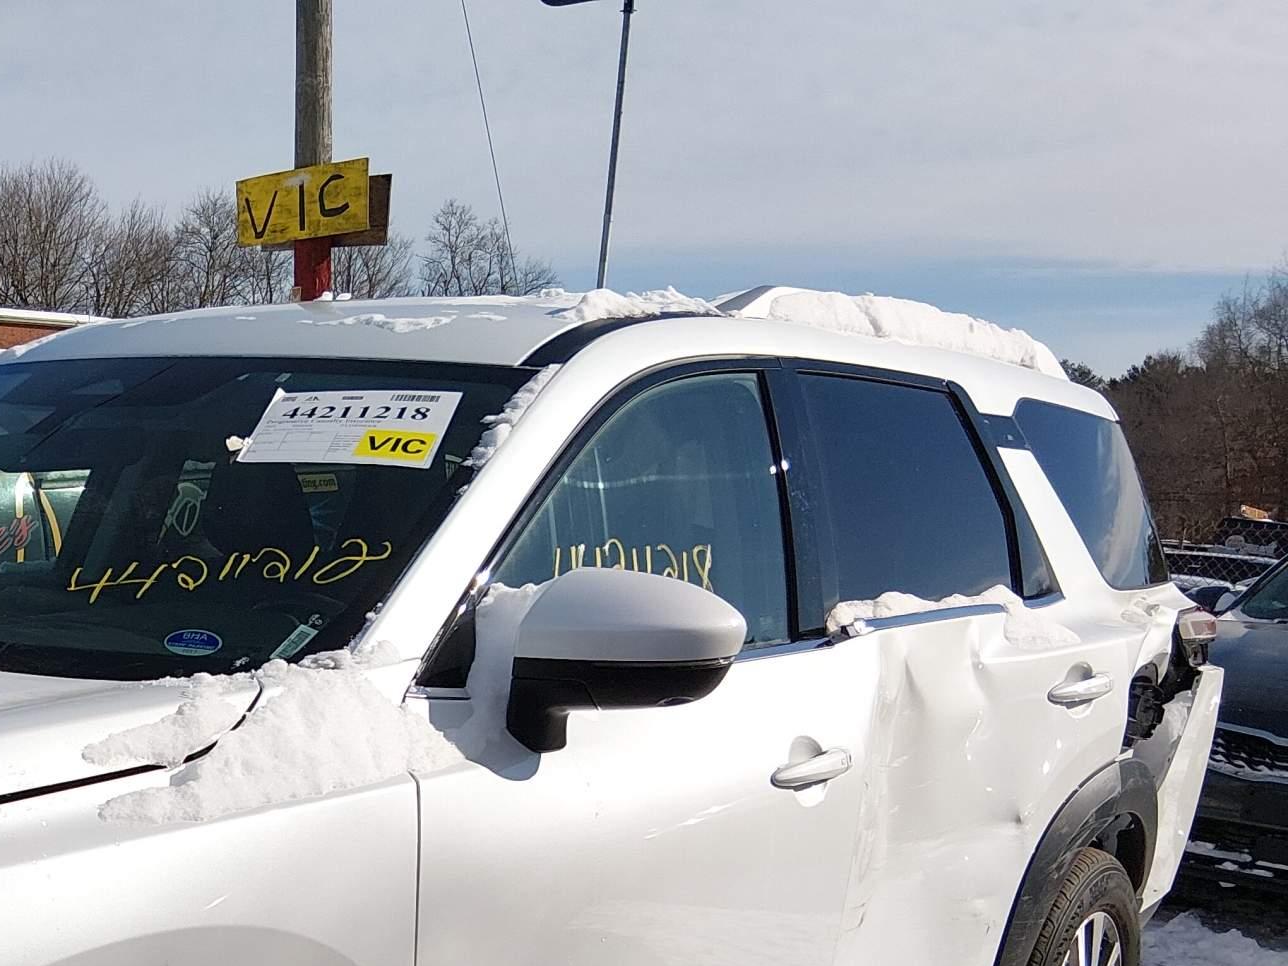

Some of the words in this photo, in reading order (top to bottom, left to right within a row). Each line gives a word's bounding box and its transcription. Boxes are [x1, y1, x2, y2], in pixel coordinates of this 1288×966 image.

[244, 173, 350, 239] VIC
[282, 405, 431, 421] 44211218
[368, 435, 428, 455] VIC
